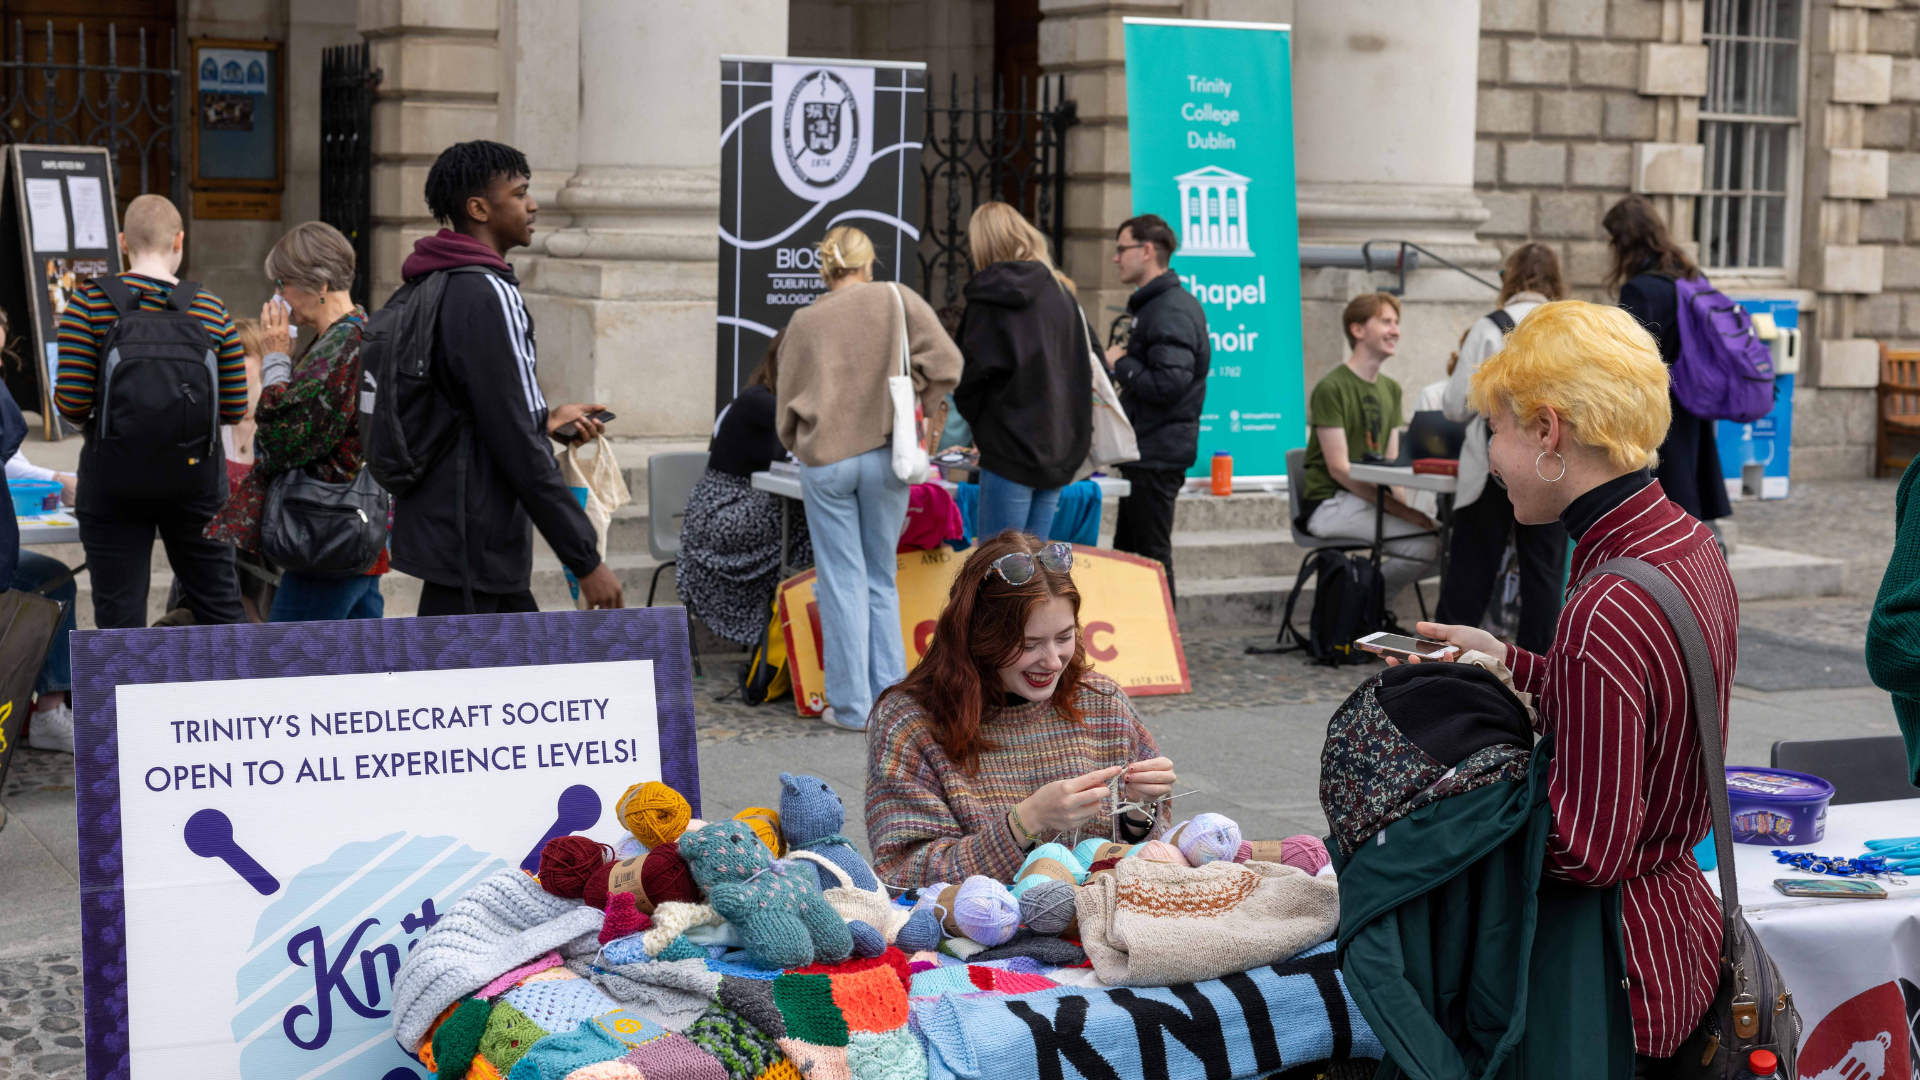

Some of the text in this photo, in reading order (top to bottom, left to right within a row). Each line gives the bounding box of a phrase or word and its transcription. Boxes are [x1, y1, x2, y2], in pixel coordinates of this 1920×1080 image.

[1187, 74, 1232, 98] Trinity
[1181, 102, 1240, 126] College
[1187, 131, 1236, 150] Dublin
[811, 158, 831, 168] 1874
[776, 248, 823, 269] BIOS
[772, 278, 808, 289] DUBLIN
[766, 293, 819, 305] BIOLOGIC
[1206, 323, 1259, 352] hoir
[310, 704, 493, 735] NEEDLECRAFT
[502, 698, 609, 725] SOCIETY
[144, 738, 637, 792] OPEN TO ALL EXPERIENCE LEVELS!
[1005, 951, 1354, 1080] KNIT
